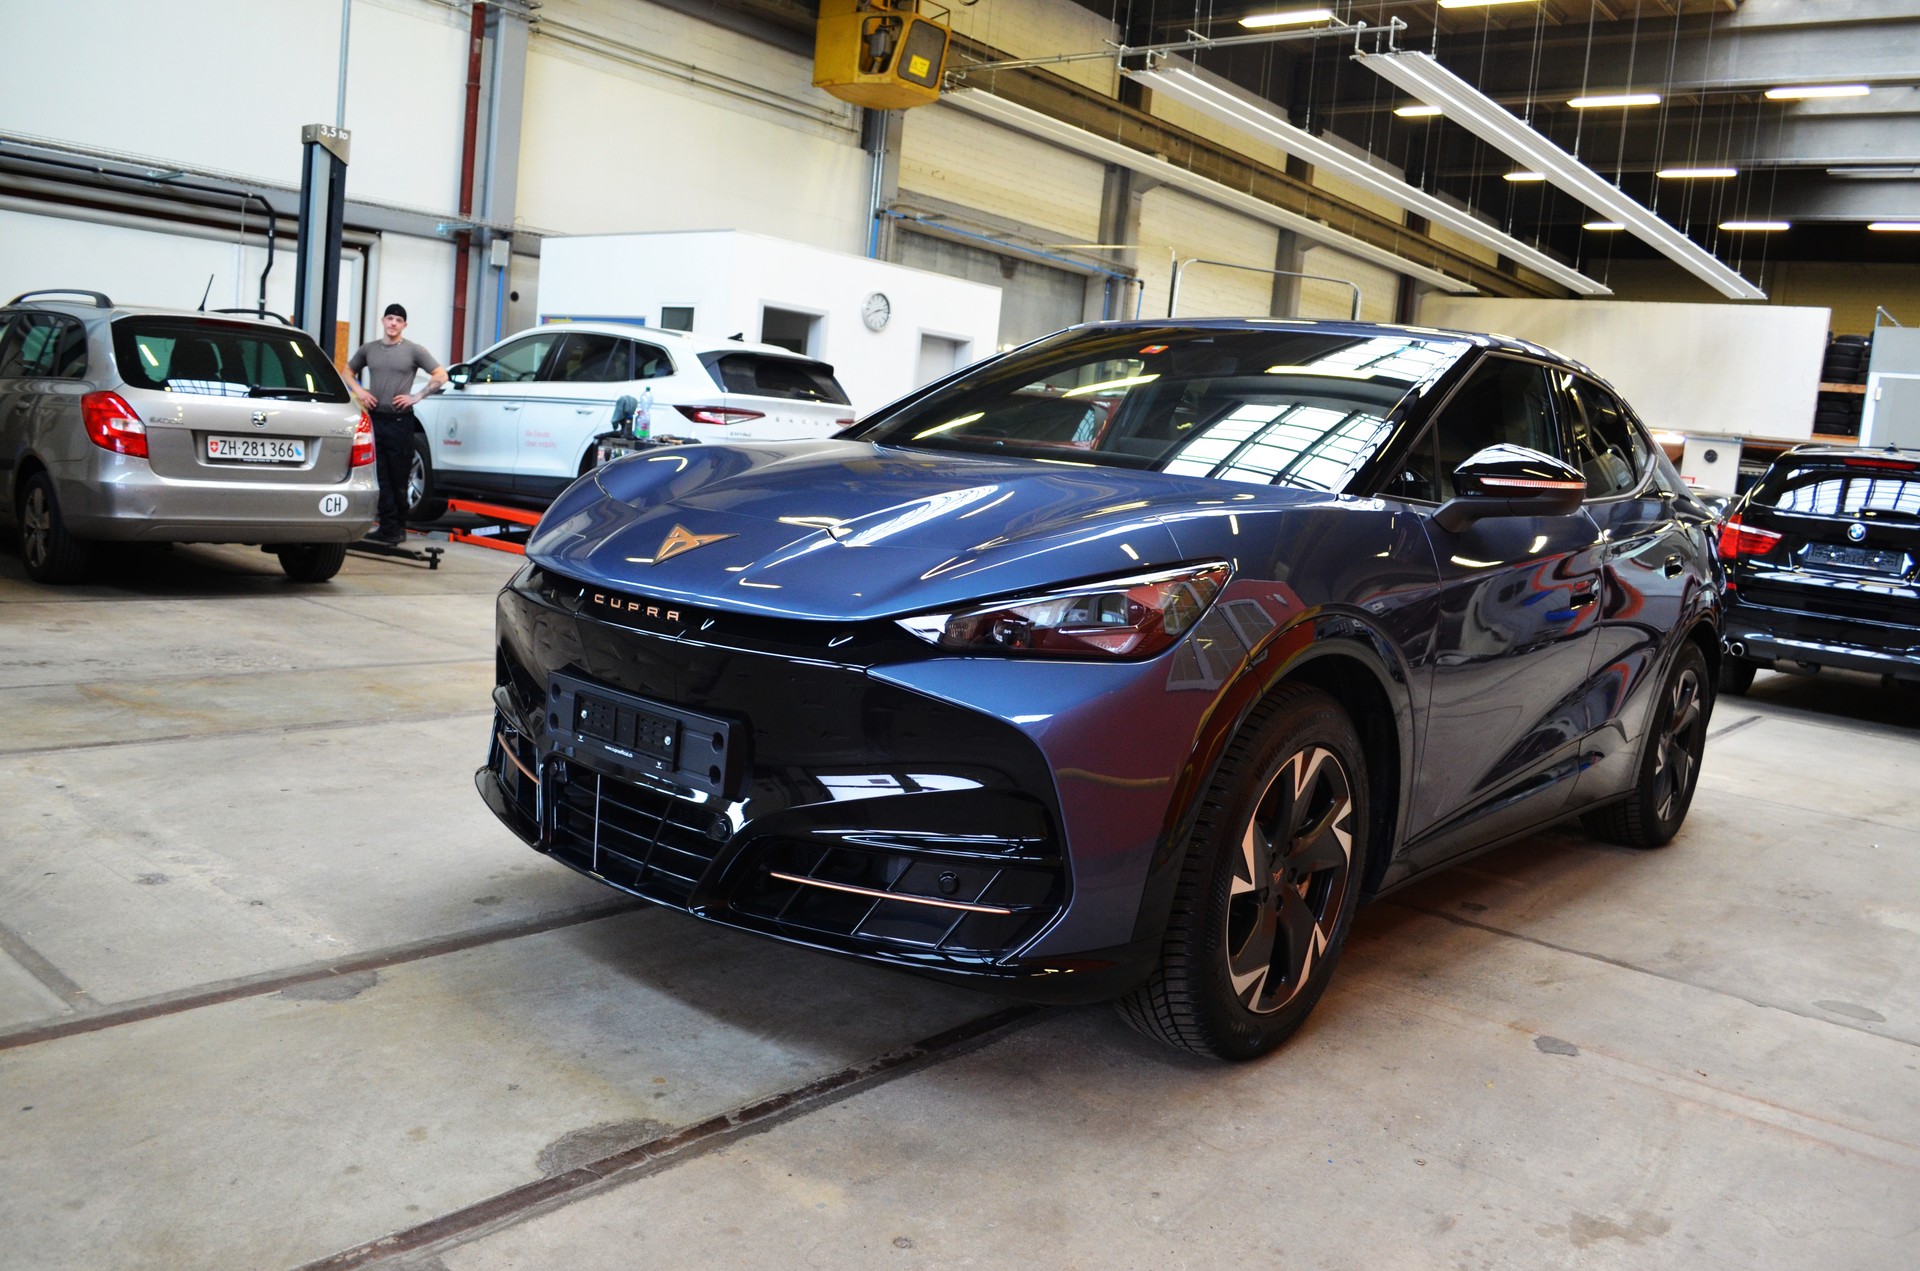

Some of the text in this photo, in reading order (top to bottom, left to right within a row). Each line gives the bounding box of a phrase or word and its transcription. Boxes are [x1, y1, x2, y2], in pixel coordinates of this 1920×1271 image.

[321, 125, 349, 140] 3,5 to
[326, 496, 342, 512] CH
[594, 593, 680, 621] CUPRA
